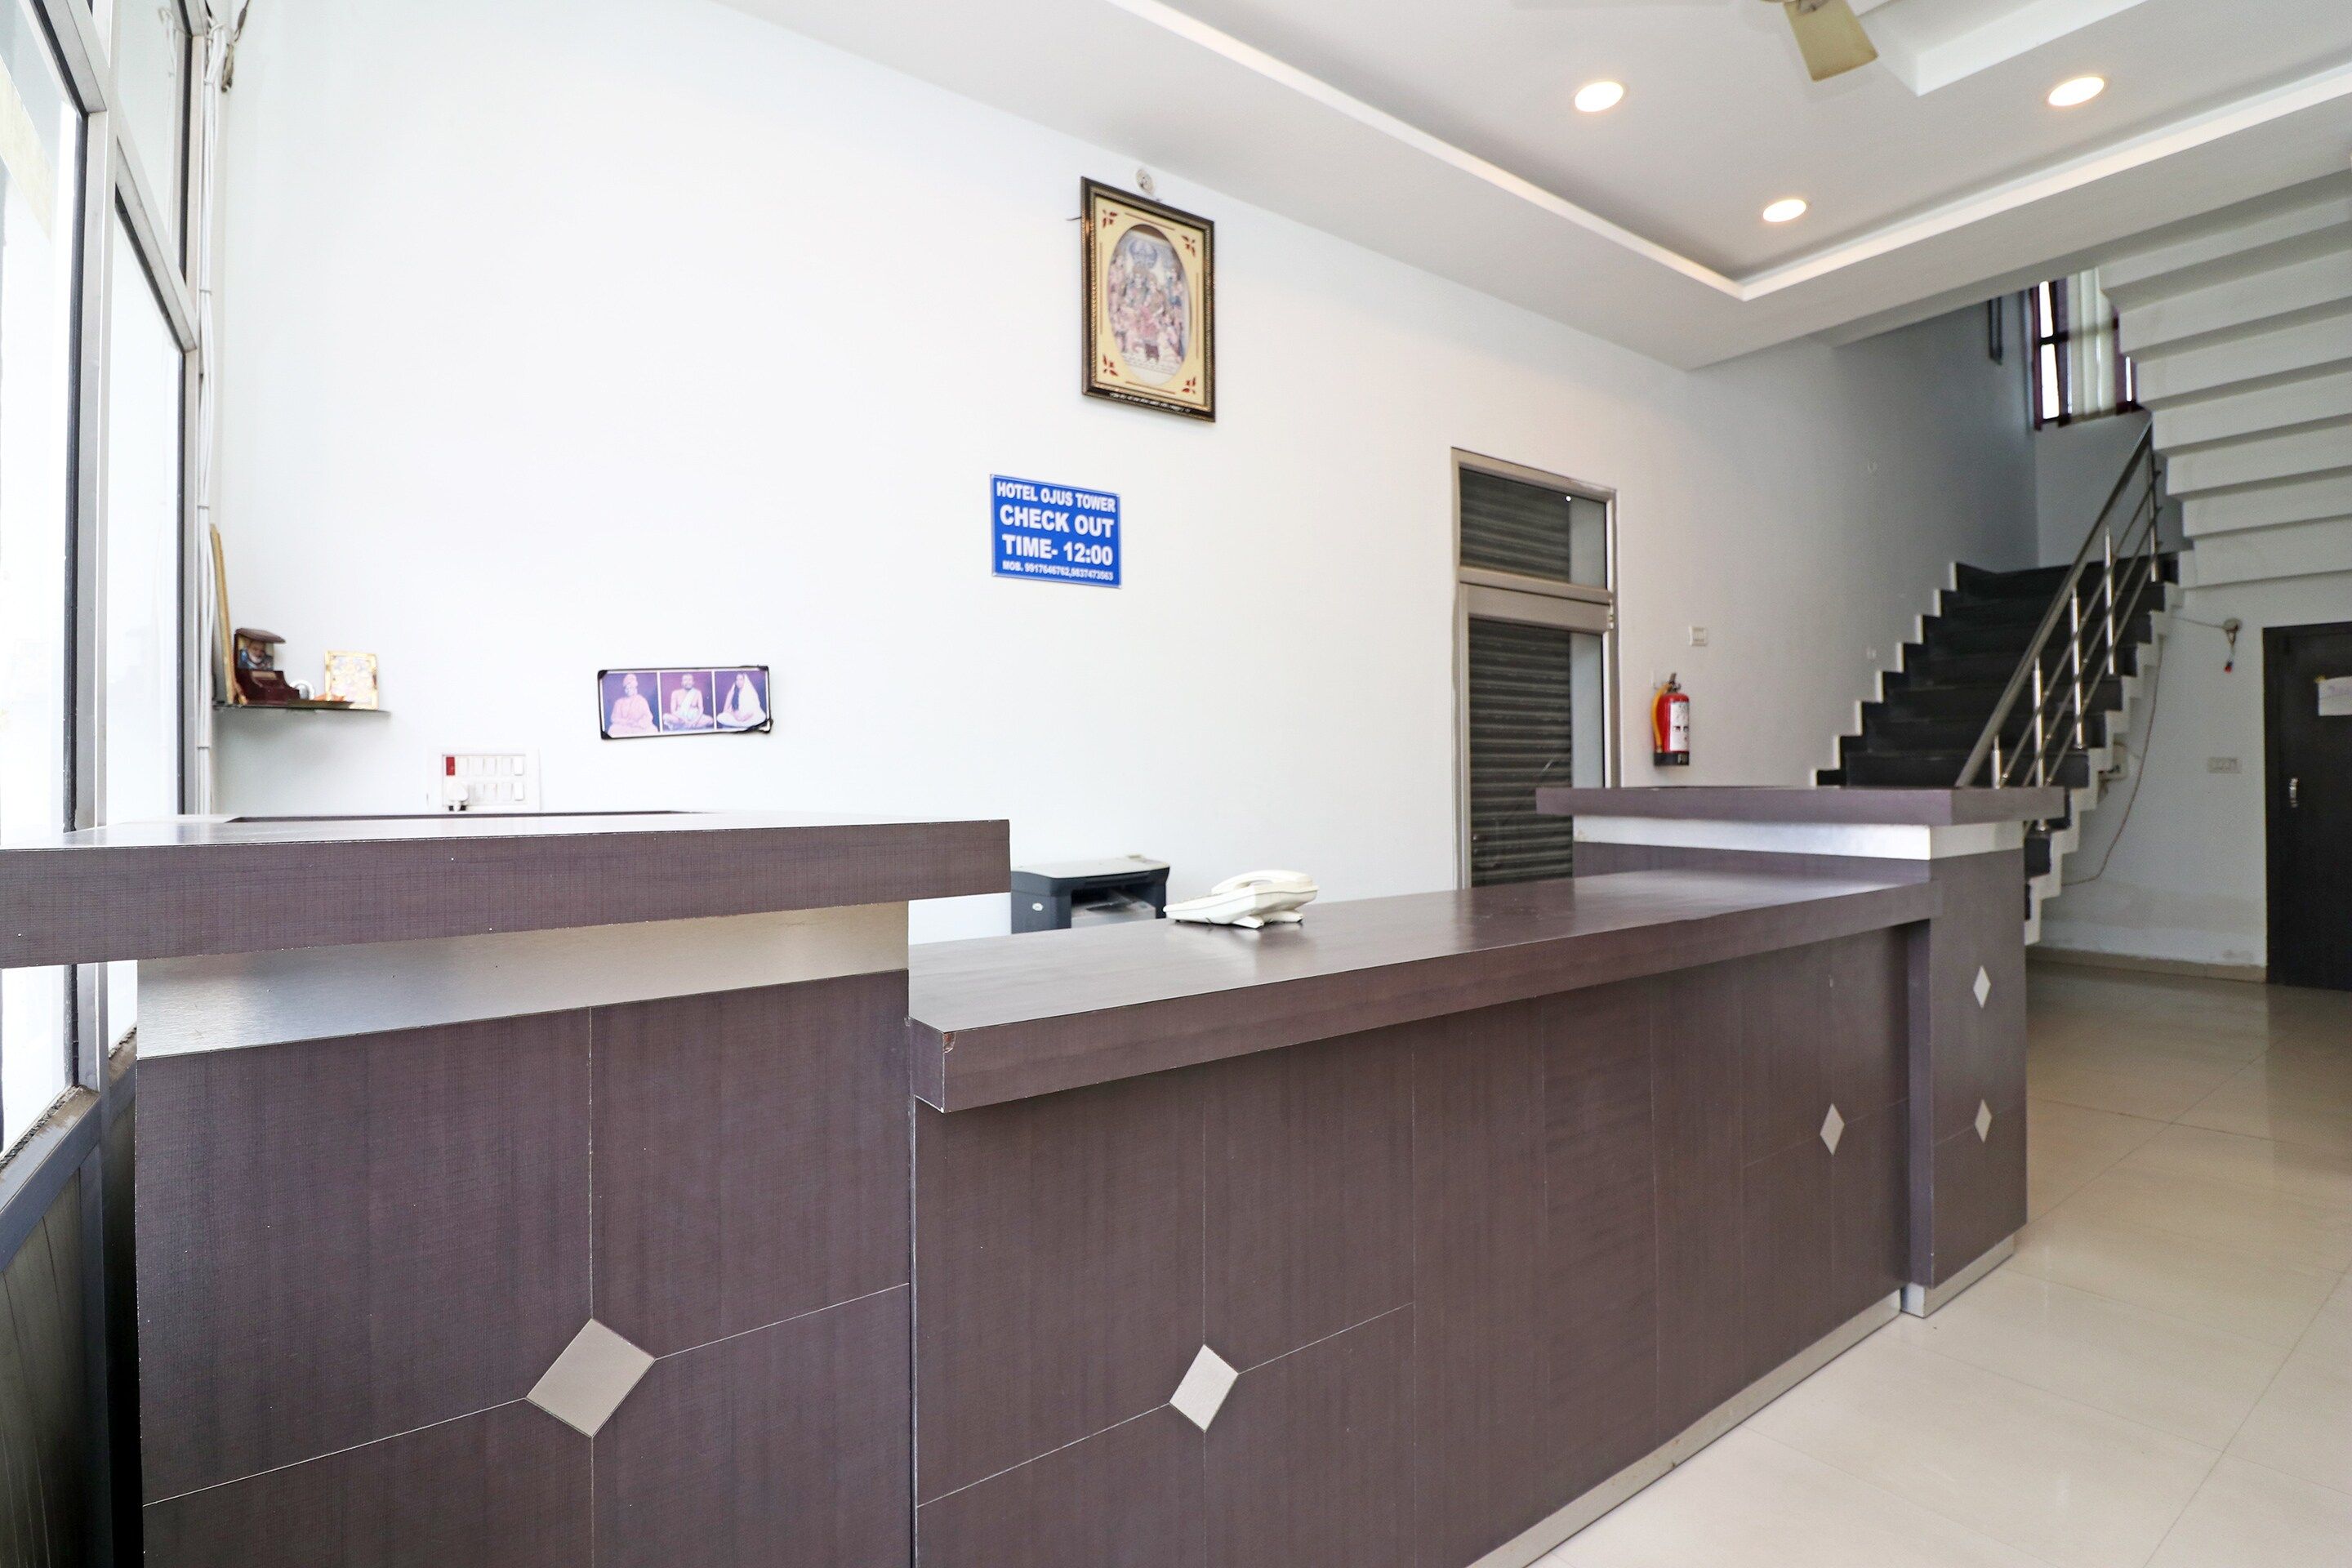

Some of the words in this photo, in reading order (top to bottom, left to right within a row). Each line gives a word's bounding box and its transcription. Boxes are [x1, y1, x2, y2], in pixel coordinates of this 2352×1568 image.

[996, 481, 1038, 501] HOTEL
[1040, 488, 1074, 507] OJUS
[1075, 492, 1116, 513] TOWER
[1000, 504, 1070, 533] CHECK
[1074, 514, 1115, 538] OUT
[1002, 533, 1058, 559] TIME-
[1063, 541, 1114, 566] 12:00
